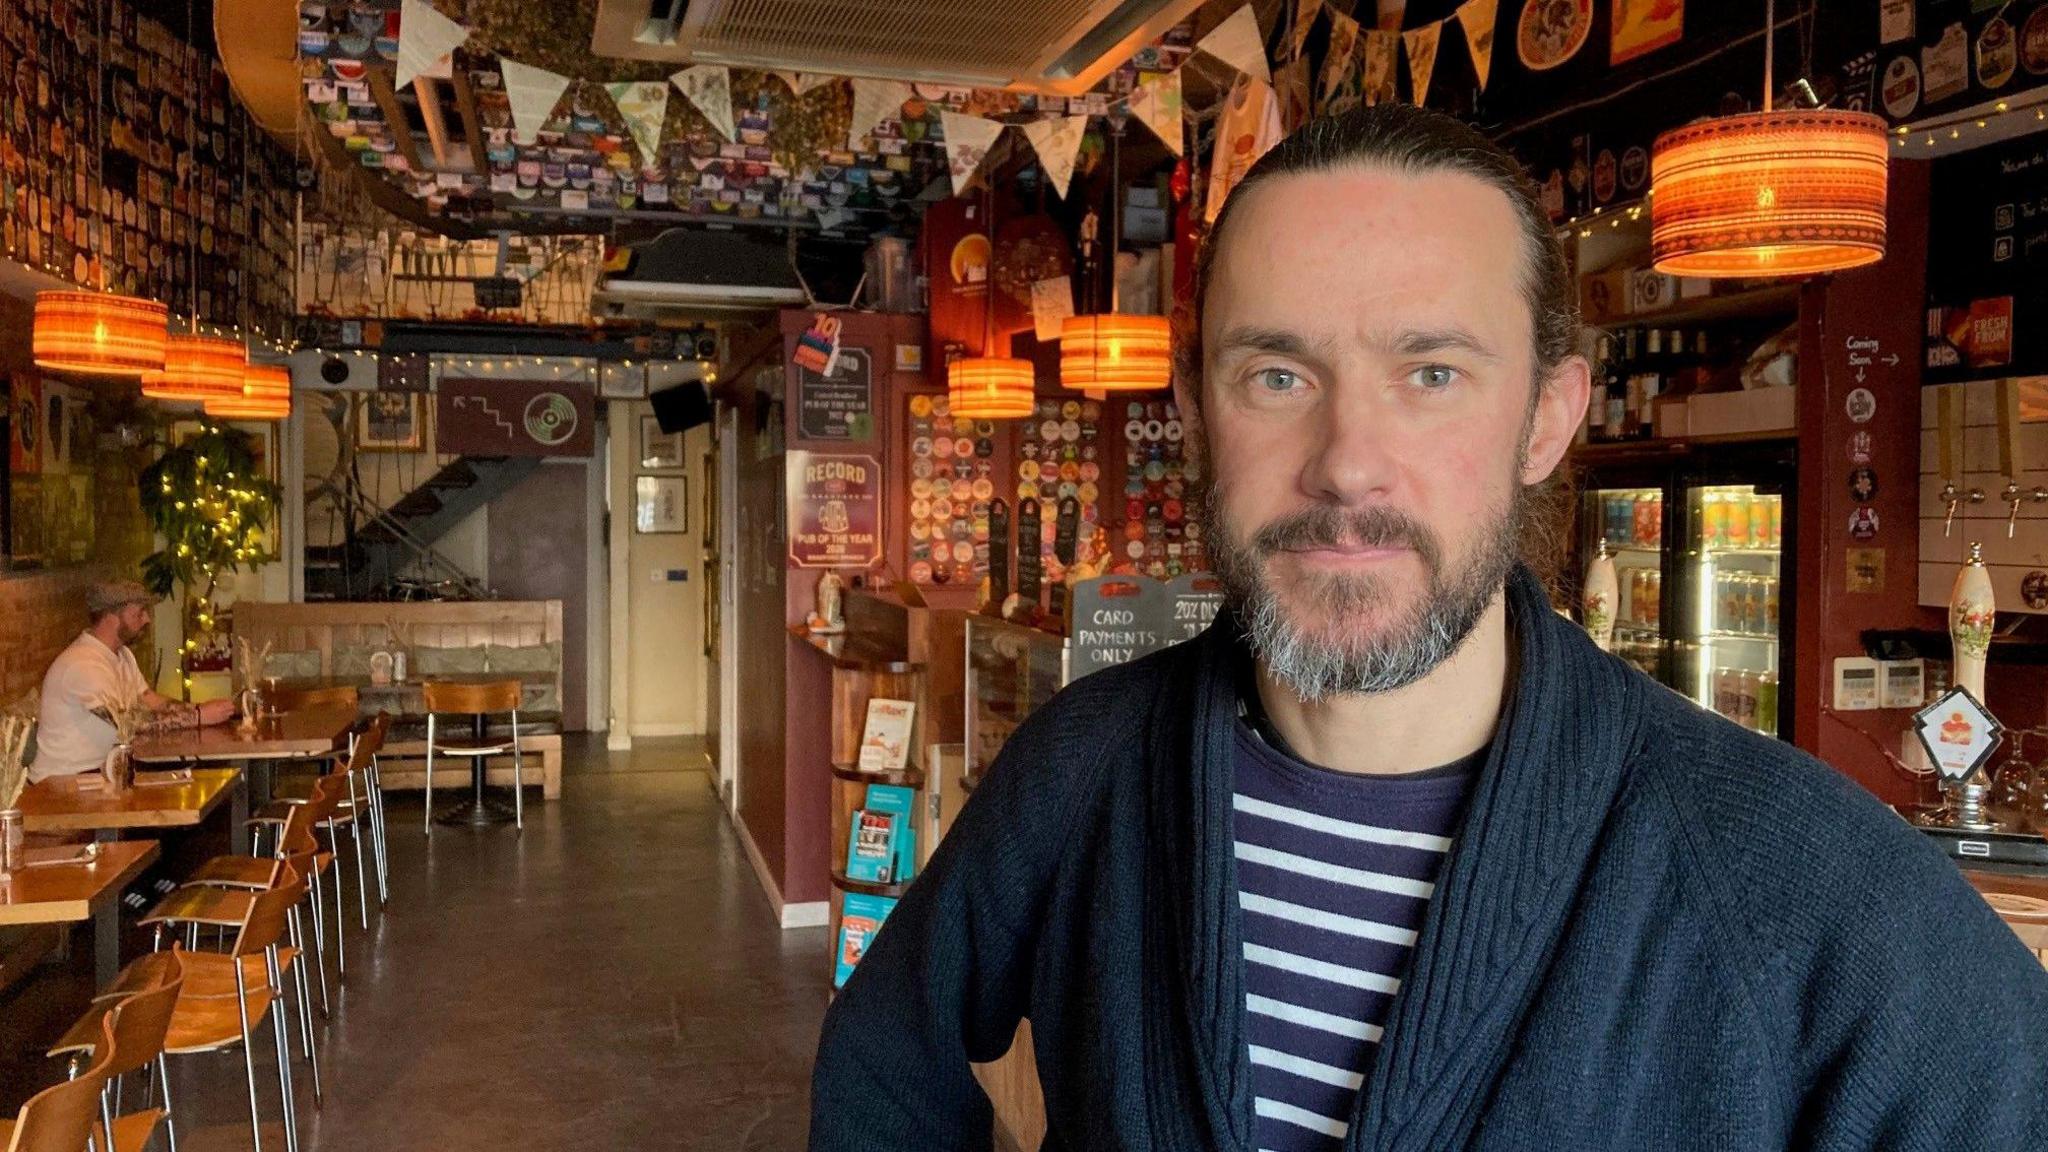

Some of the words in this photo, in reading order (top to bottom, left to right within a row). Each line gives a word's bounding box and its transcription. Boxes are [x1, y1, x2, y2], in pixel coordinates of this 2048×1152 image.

[1846, 335, 1879, 351] Coming
[1849, 351, 1872, 366] Soon
[806, 462, 866, 484] RECORD
[799, 534, 816, 543] PUB
[818, 534, 829, 543] OF
[832, 534, 848, 543] THE
[850, 534, 873, 543] YEAR
[1093, 609, 1134, 625] CARD
[1201, 601, 1223, 621] DIS
[1079, 629, 1156, 646] PAYMENTS
[1091, 648, 1134, 664] ONLY
